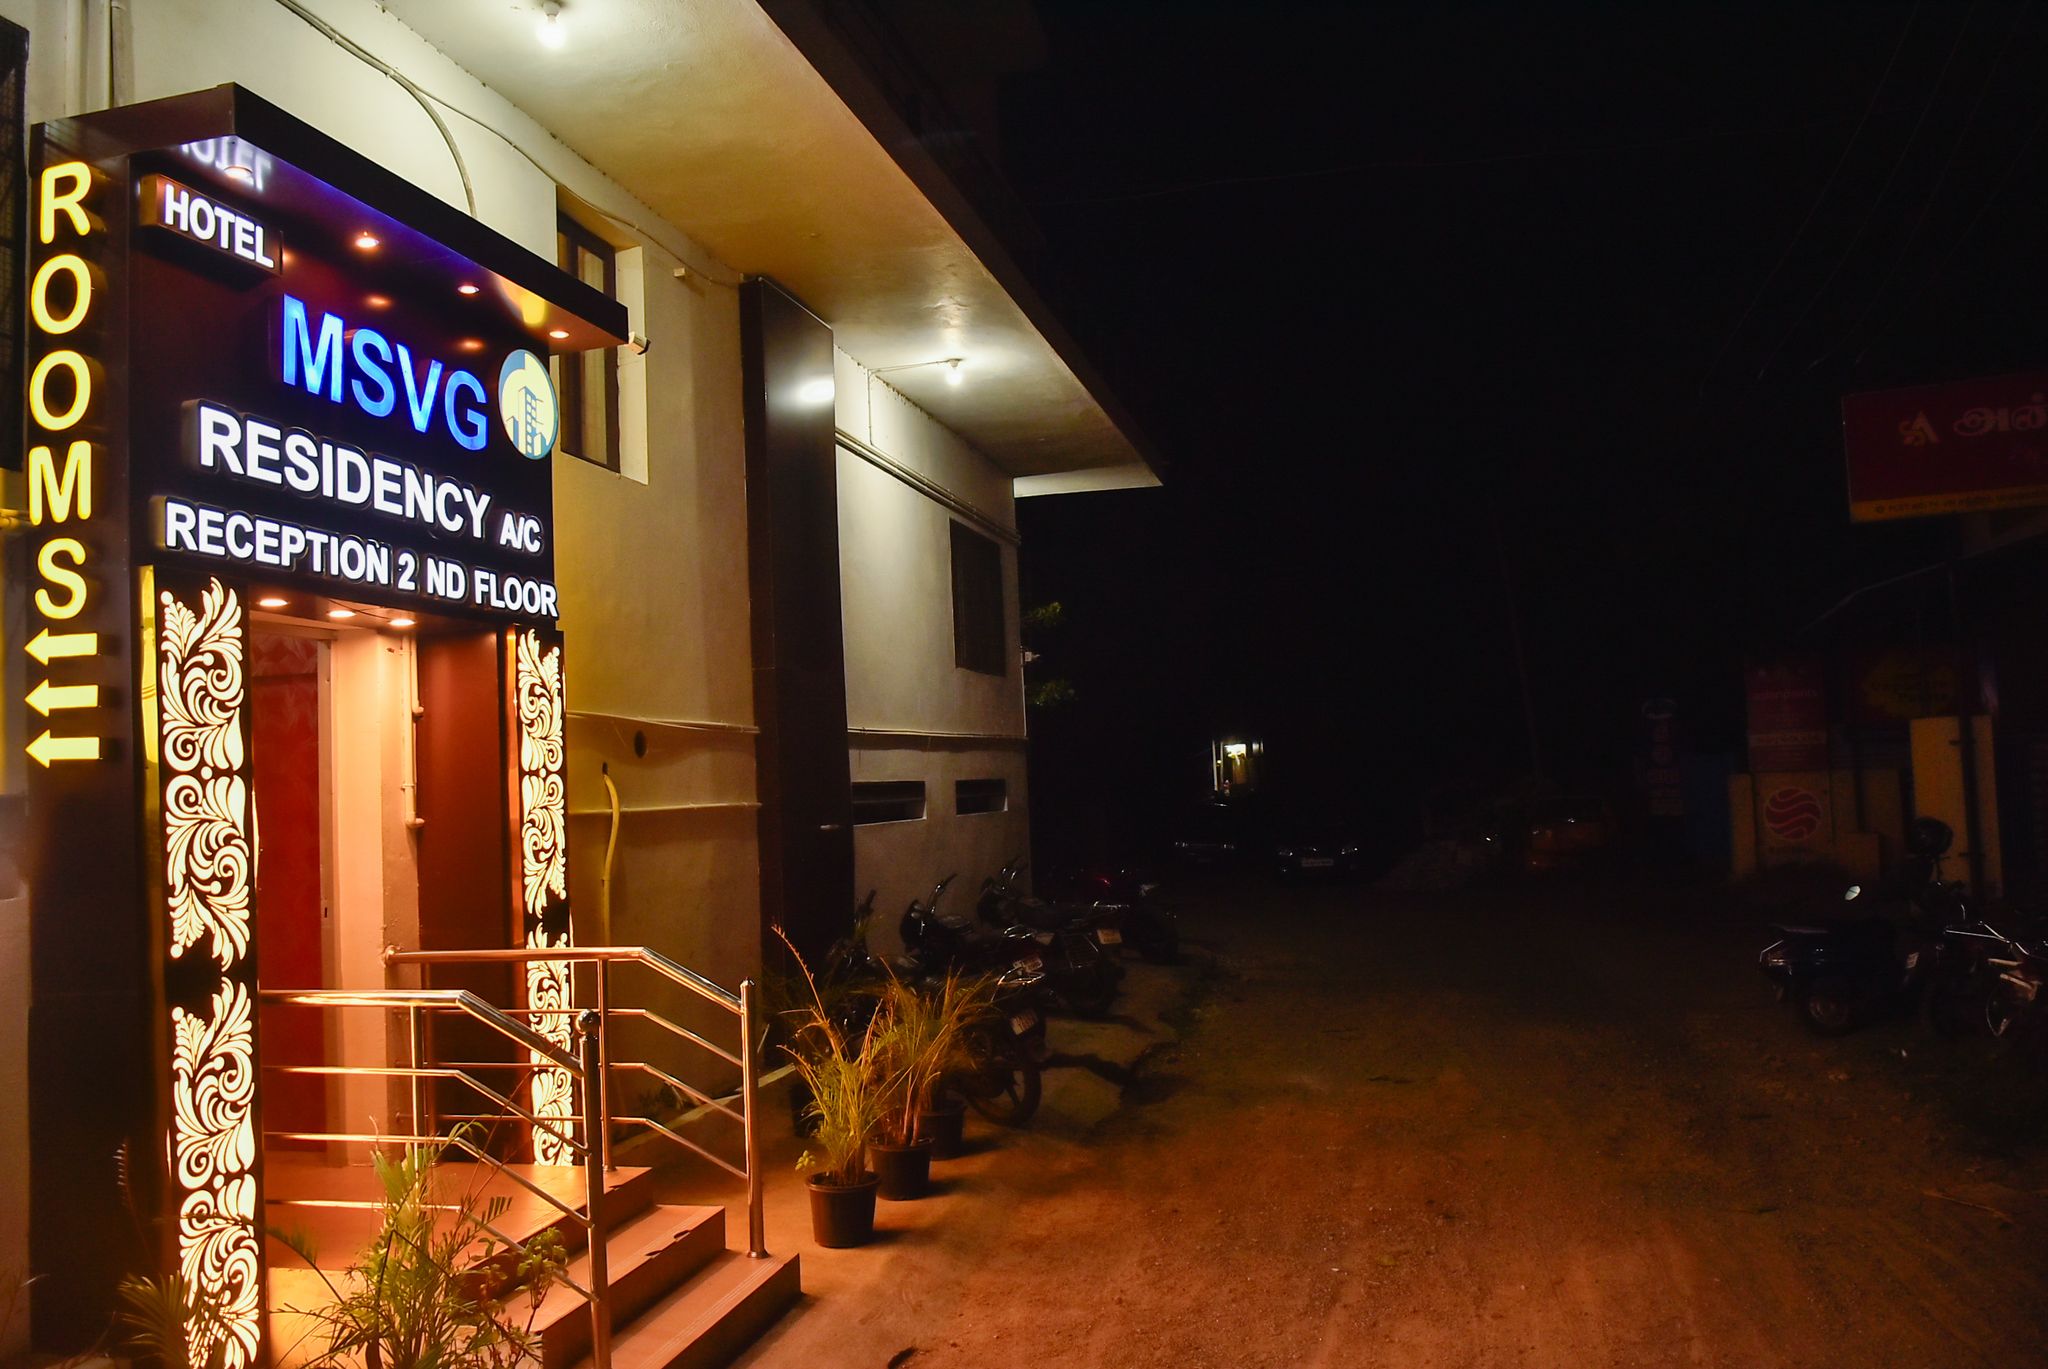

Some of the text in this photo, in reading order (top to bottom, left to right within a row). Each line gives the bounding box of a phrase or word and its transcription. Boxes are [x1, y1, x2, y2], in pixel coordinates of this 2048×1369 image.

[165, 183, 274, 268] HOTEL
[29, 161, 92, 621] ROOMS
[282, 293, 489, 451] MSVG
[200, 406, 541, 553] RESIDENCY A/C
[166, 502, 559, 617] RECEPTION 2 ND FLOOR
